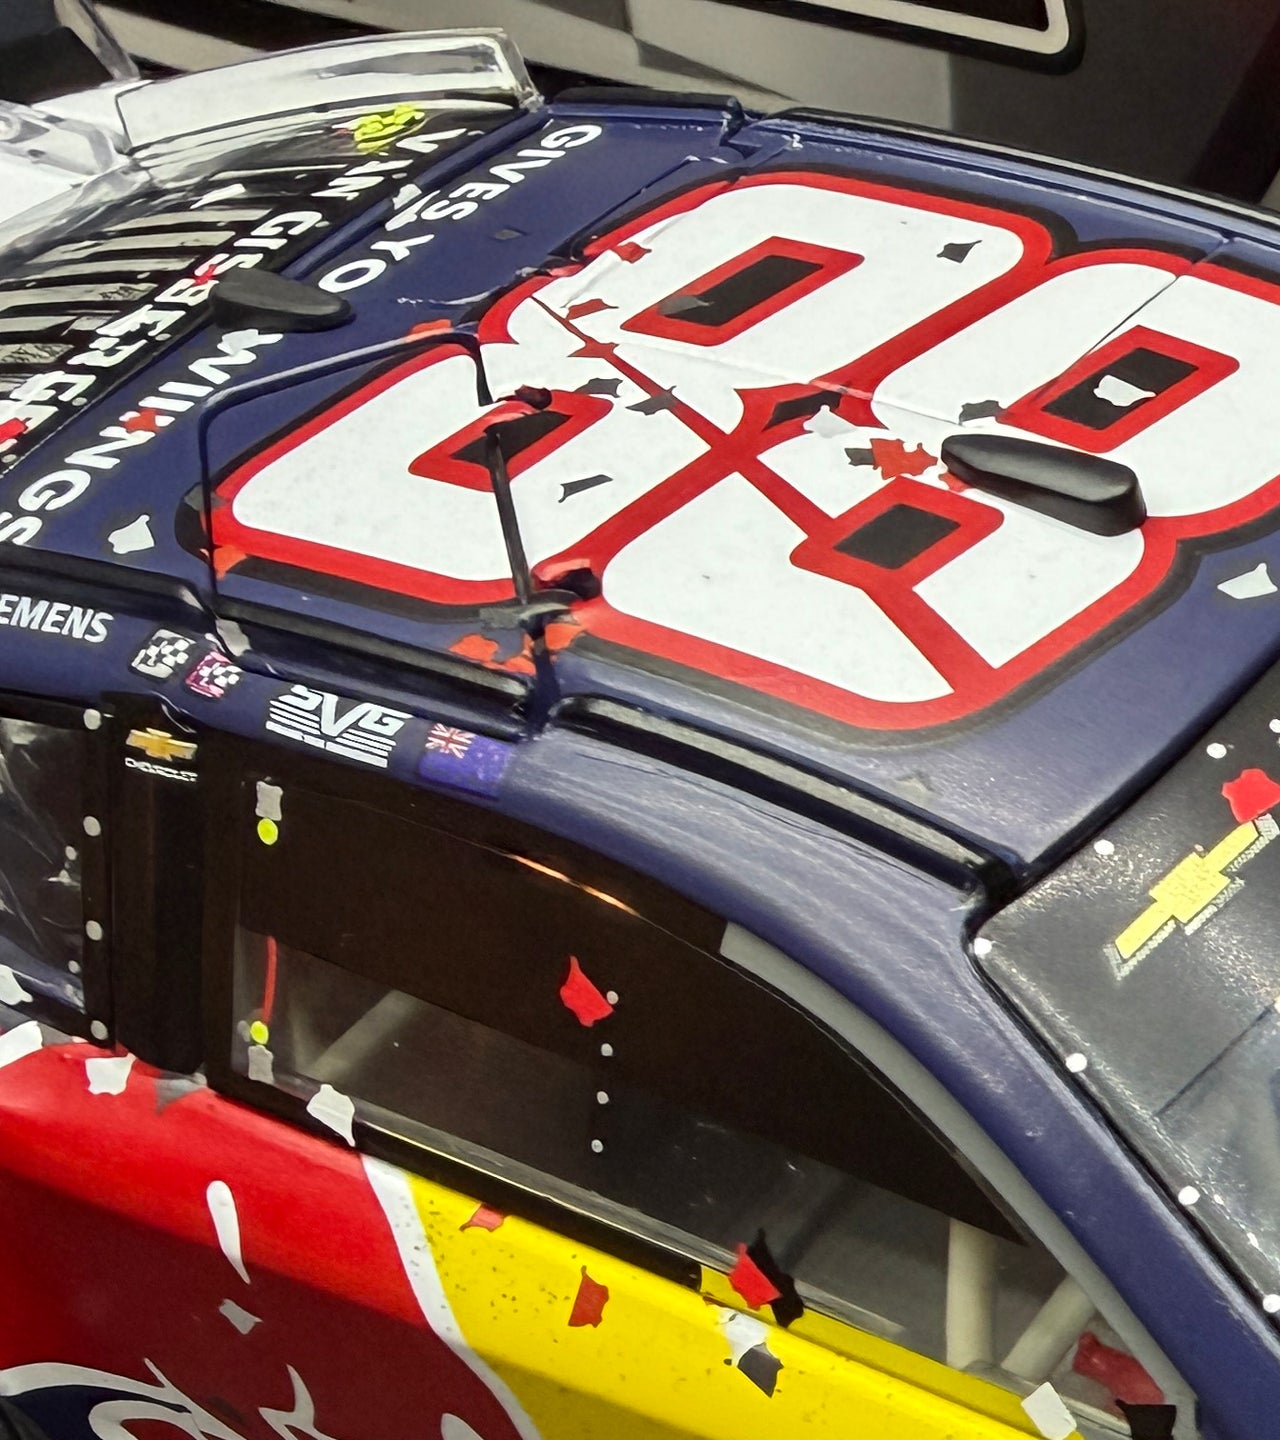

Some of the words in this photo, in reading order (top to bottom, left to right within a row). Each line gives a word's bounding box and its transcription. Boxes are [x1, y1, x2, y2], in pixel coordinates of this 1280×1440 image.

[420, 124, 603, 221] GIVES
[318, 233, 436, 294] YO
[0, 594, 114, 643] EMENS
